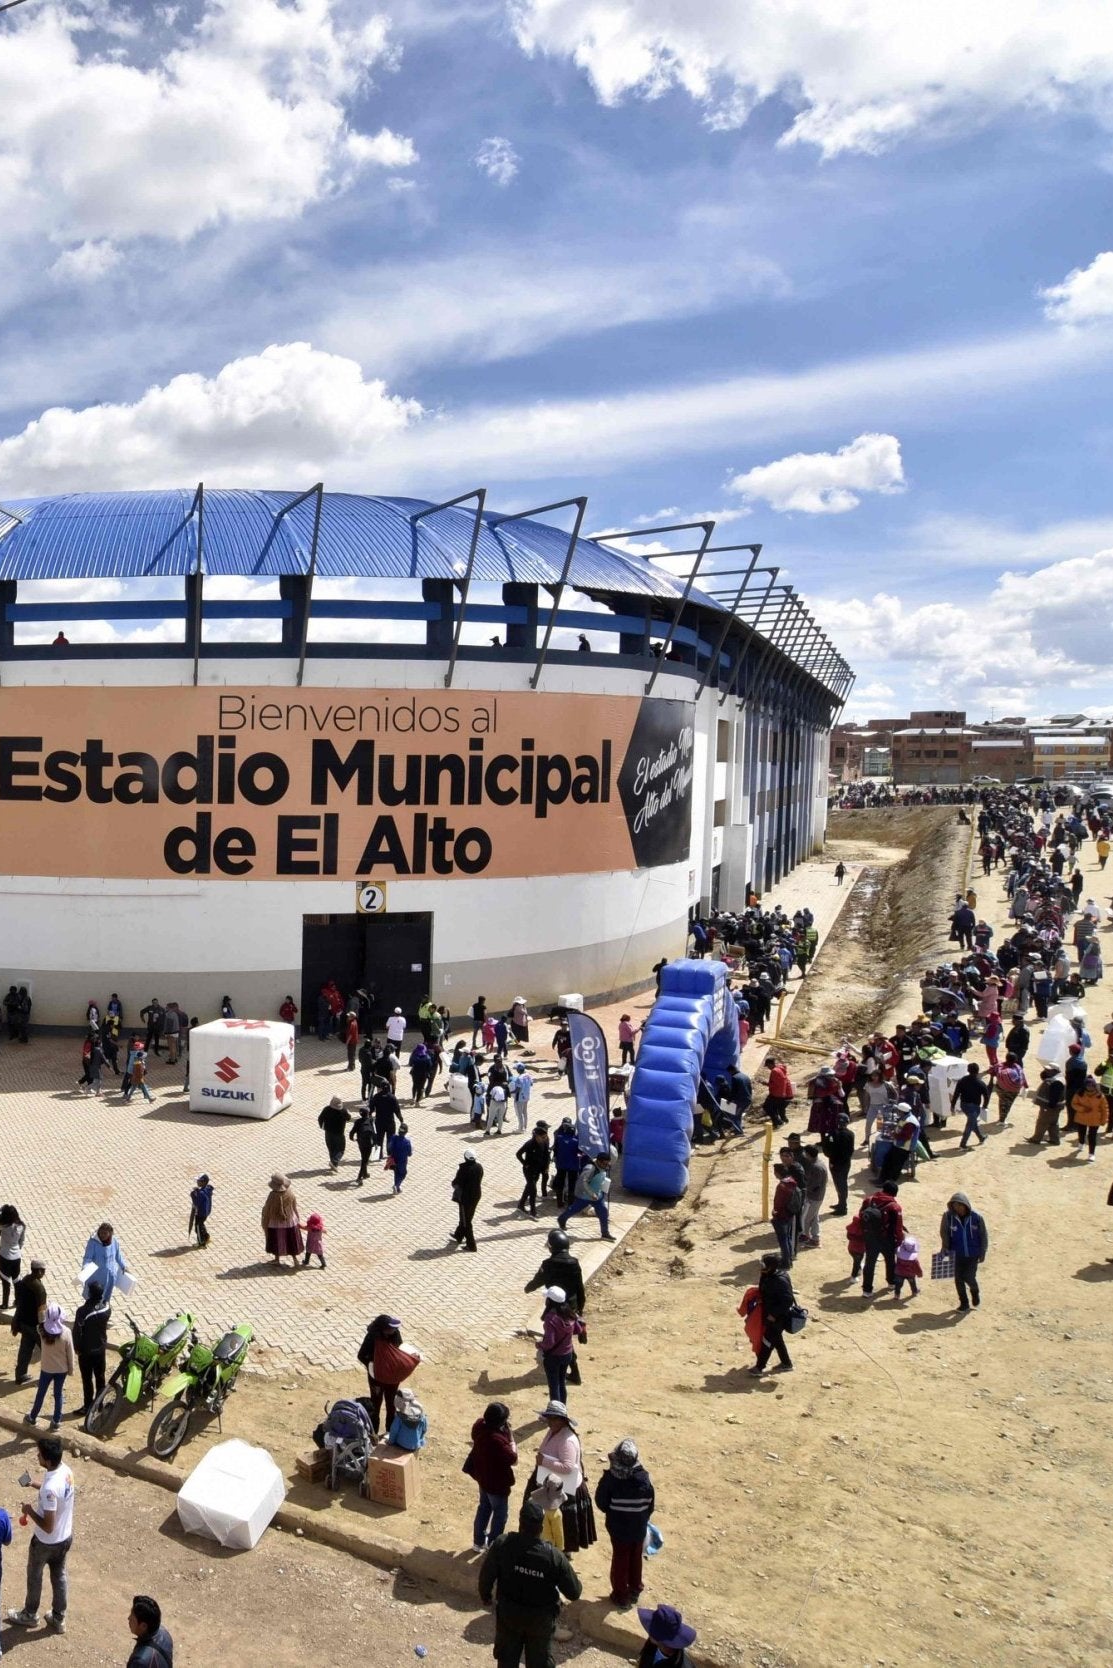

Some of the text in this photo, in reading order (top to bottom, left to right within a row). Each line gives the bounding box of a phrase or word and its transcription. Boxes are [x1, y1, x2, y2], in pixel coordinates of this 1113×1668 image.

[219, 695, 497, 733] Bienvenidos al
[310, 738, 611, 818] Municipal
[633, 756, 650, 796] El
[649, 741, 678, 781] estadio
[633, 790, 659, 834] Alto
[659, 776, 674, 810] del
[163, 812, 492, 875] de El Alto
[366, 890, 376, 909] 2
[201, 1087, 255, 1101] SUZUKI
[514, 1565, 544, 1578] POLICIA
